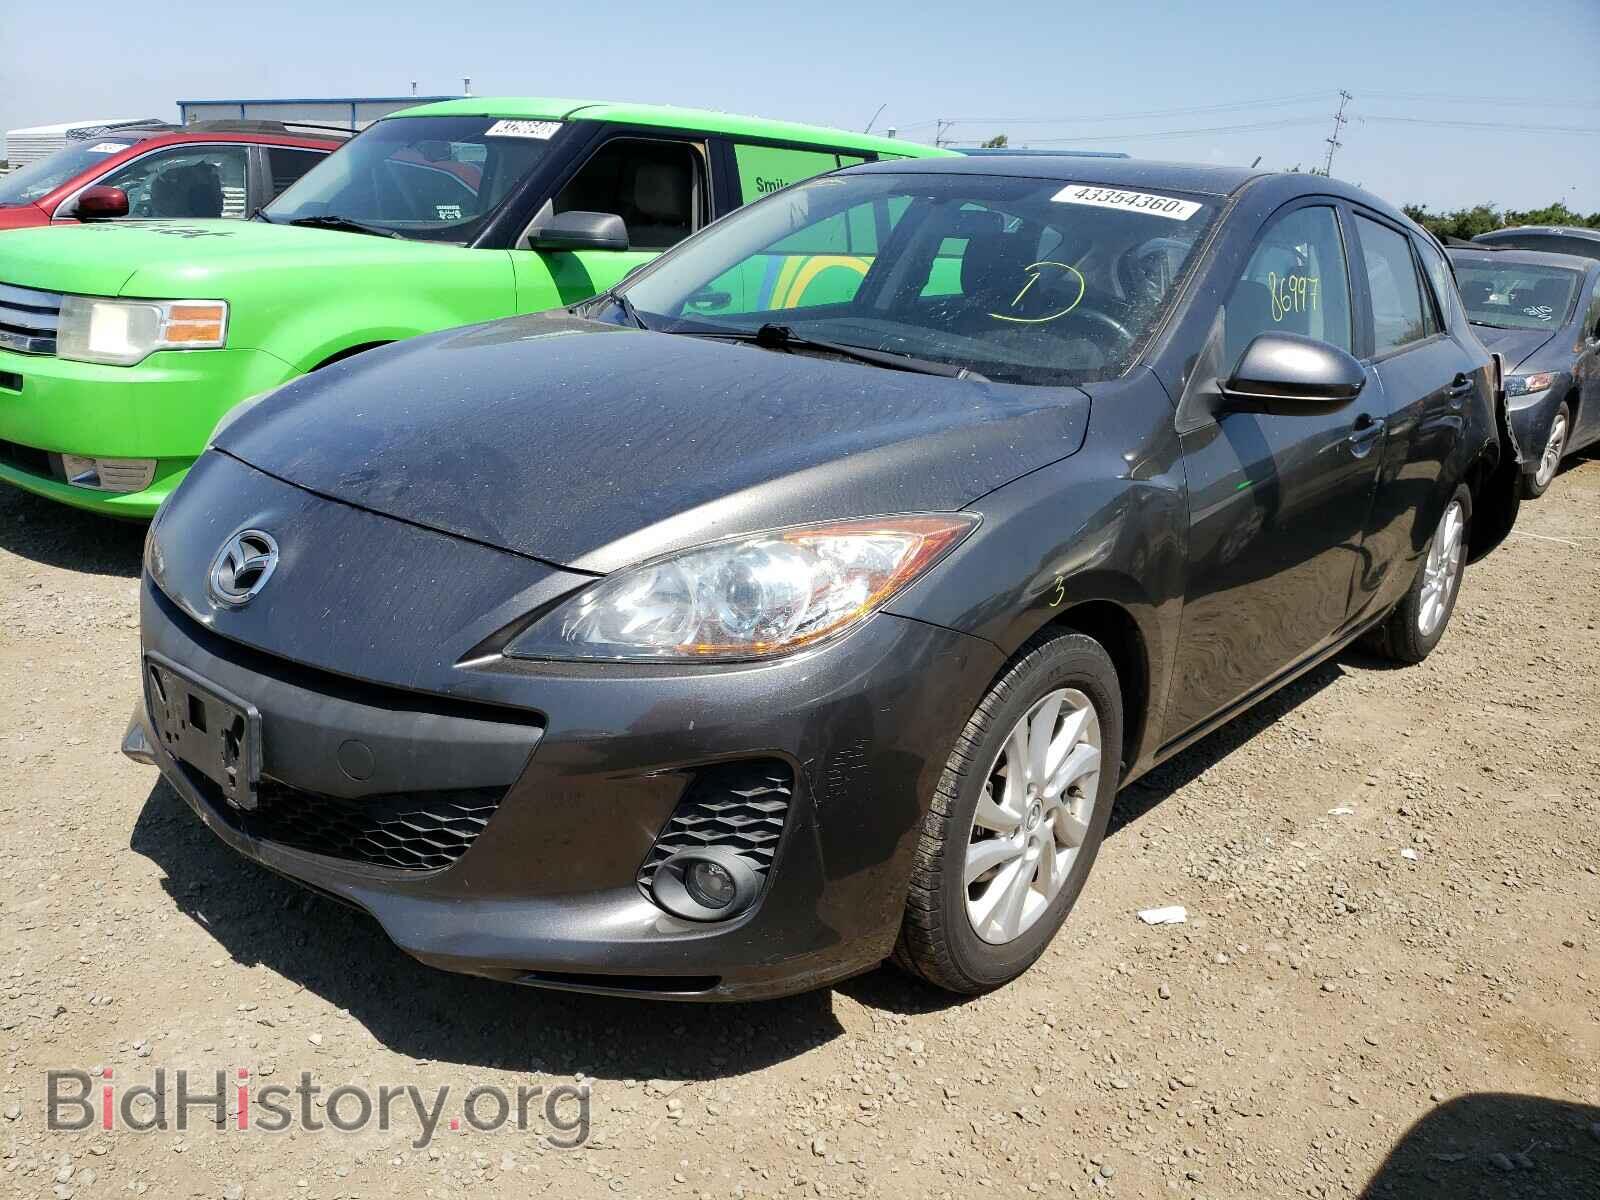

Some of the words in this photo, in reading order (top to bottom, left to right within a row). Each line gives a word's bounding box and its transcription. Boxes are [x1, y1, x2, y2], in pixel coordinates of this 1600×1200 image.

[756, 177, 789, 193] Smil
[1074, 187, 1180, 213] 43354360
[1269, 271, 1319, 322] 86997
